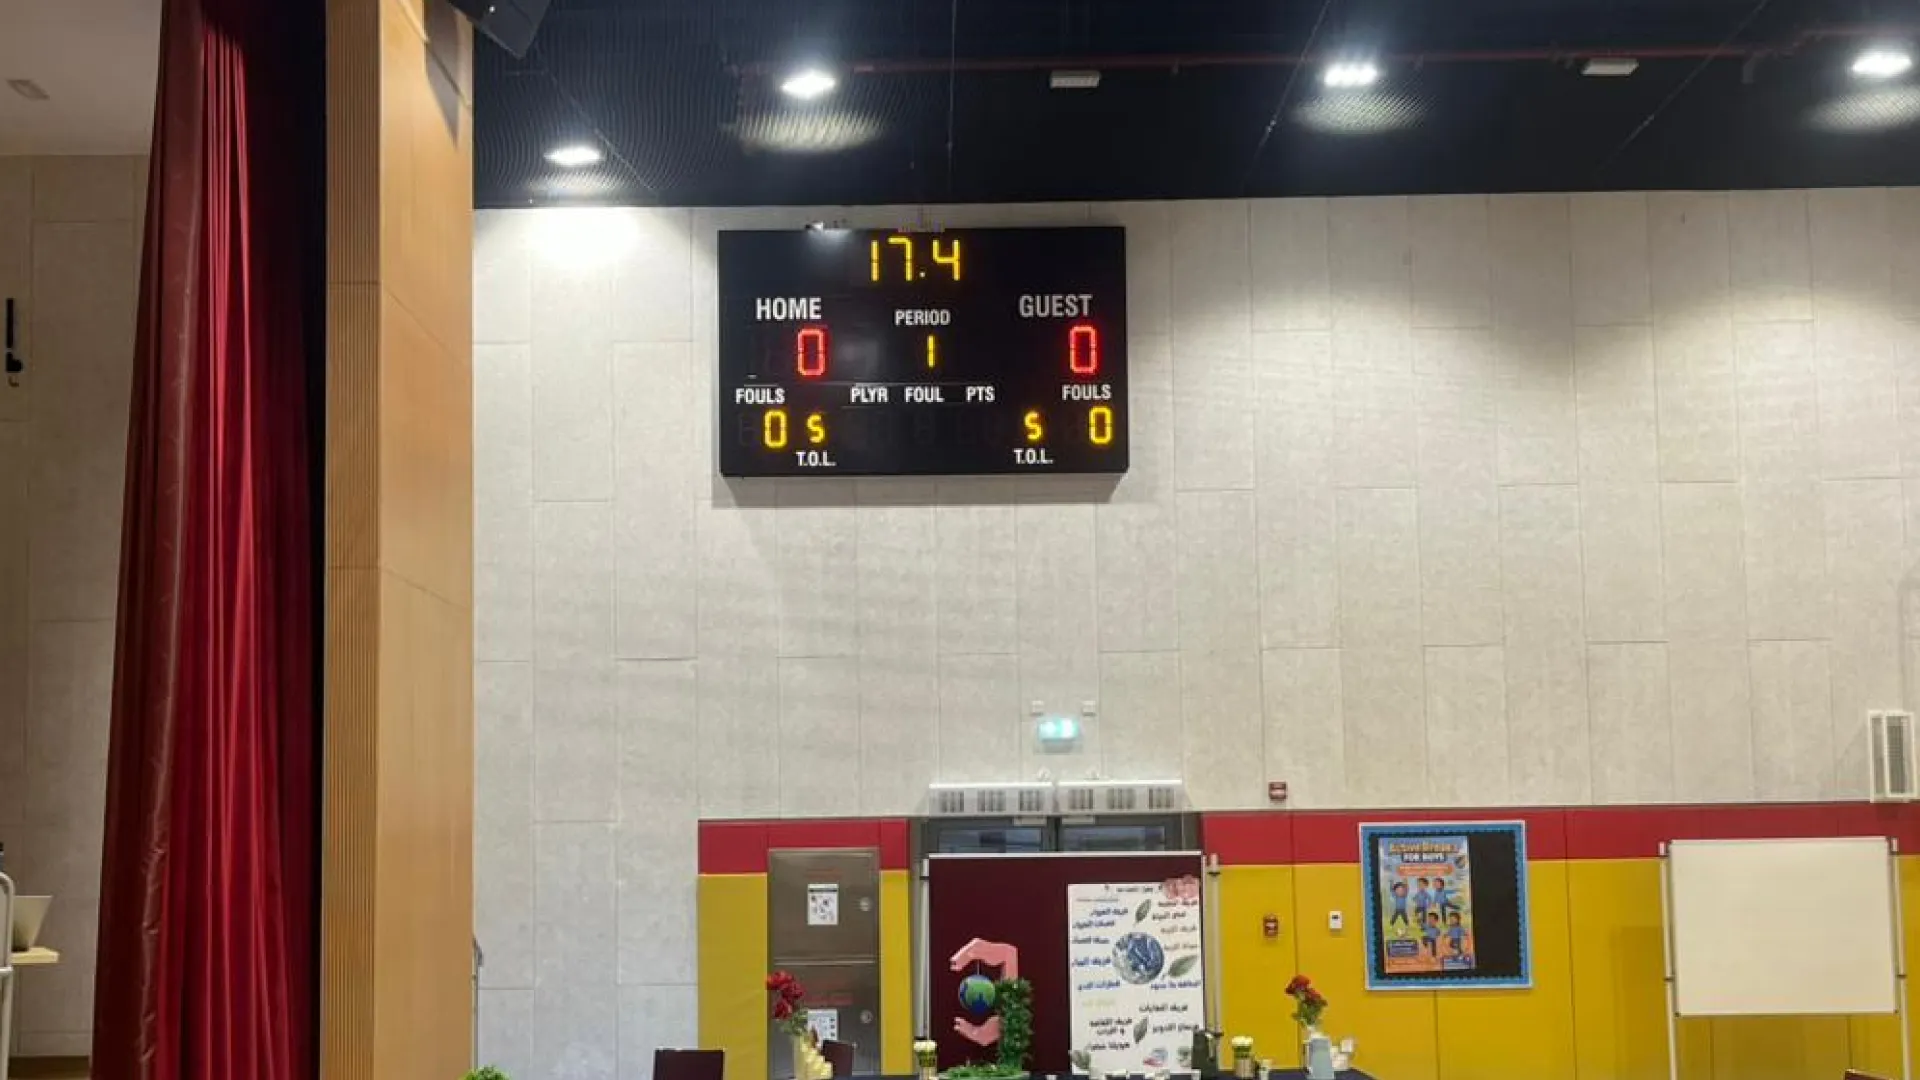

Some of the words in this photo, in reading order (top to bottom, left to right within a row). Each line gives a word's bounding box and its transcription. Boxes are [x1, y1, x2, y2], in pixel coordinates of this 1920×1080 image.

[870, 236, 960, 281] 17.4
[756, 297, 822, 320] HOME
[895, 309, 950, 326] PERIOD
[1019, 294, 1093, 318] GUEST
[797, 328, 825, 376] 0
[1069, 325, 1097, 374] 0
[735, 387, 786, 404] FOULS
[851, 386, 888, 403] PLYR
[905, 386, 945, 402] FOUL
[966, 386, 995, 402] PTS
[1061, 384, 1111, 400] FOULS
[764, 409, 788, 448] 0
[1089, 406, 1113, 444] 0
[796, 451, 836, 466] T.O.L.
[1013, 448, 1053, 464] T.O.L.
